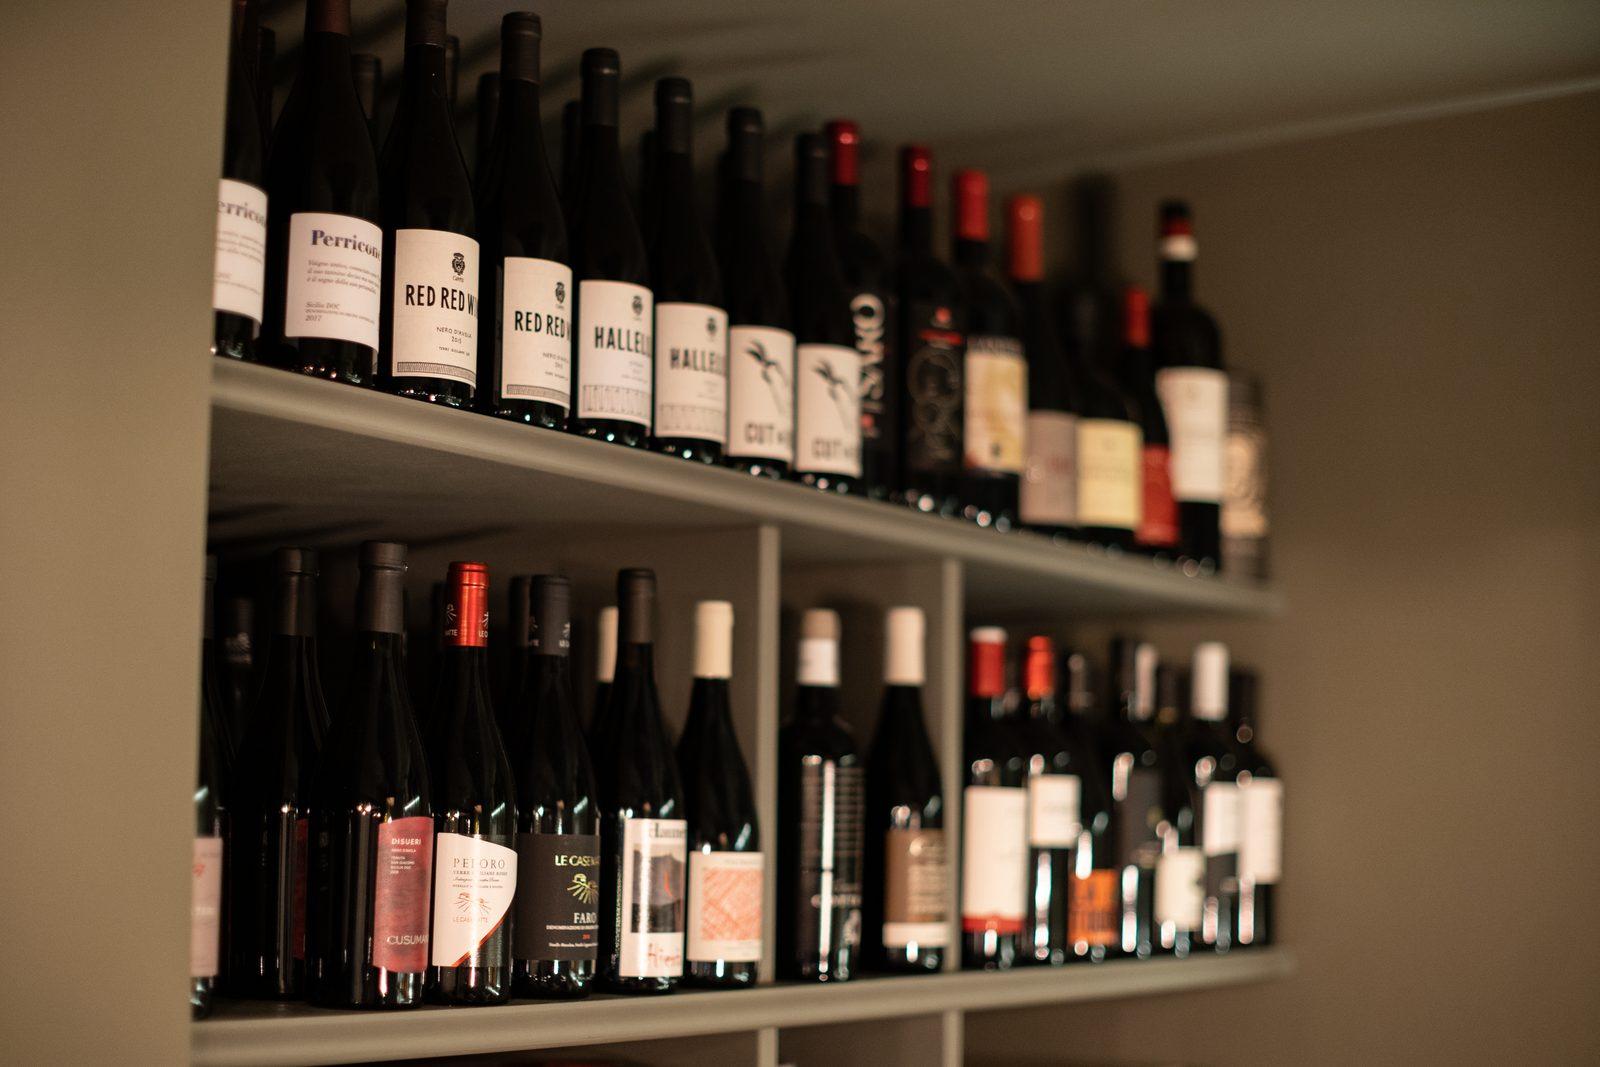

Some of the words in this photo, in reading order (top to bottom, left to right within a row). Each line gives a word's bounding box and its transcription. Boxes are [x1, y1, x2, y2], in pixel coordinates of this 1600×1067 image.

[405, 284, 436, 307] RED
[441, 286, 465, 312] RED
[515, 310, 542, 333] RED
[547, 314, 565, 338] RED
[391, 838, 422, 846] DISUERI
[555, 855, 568, 866] LE
[574, 912, 597, 924] FARO
